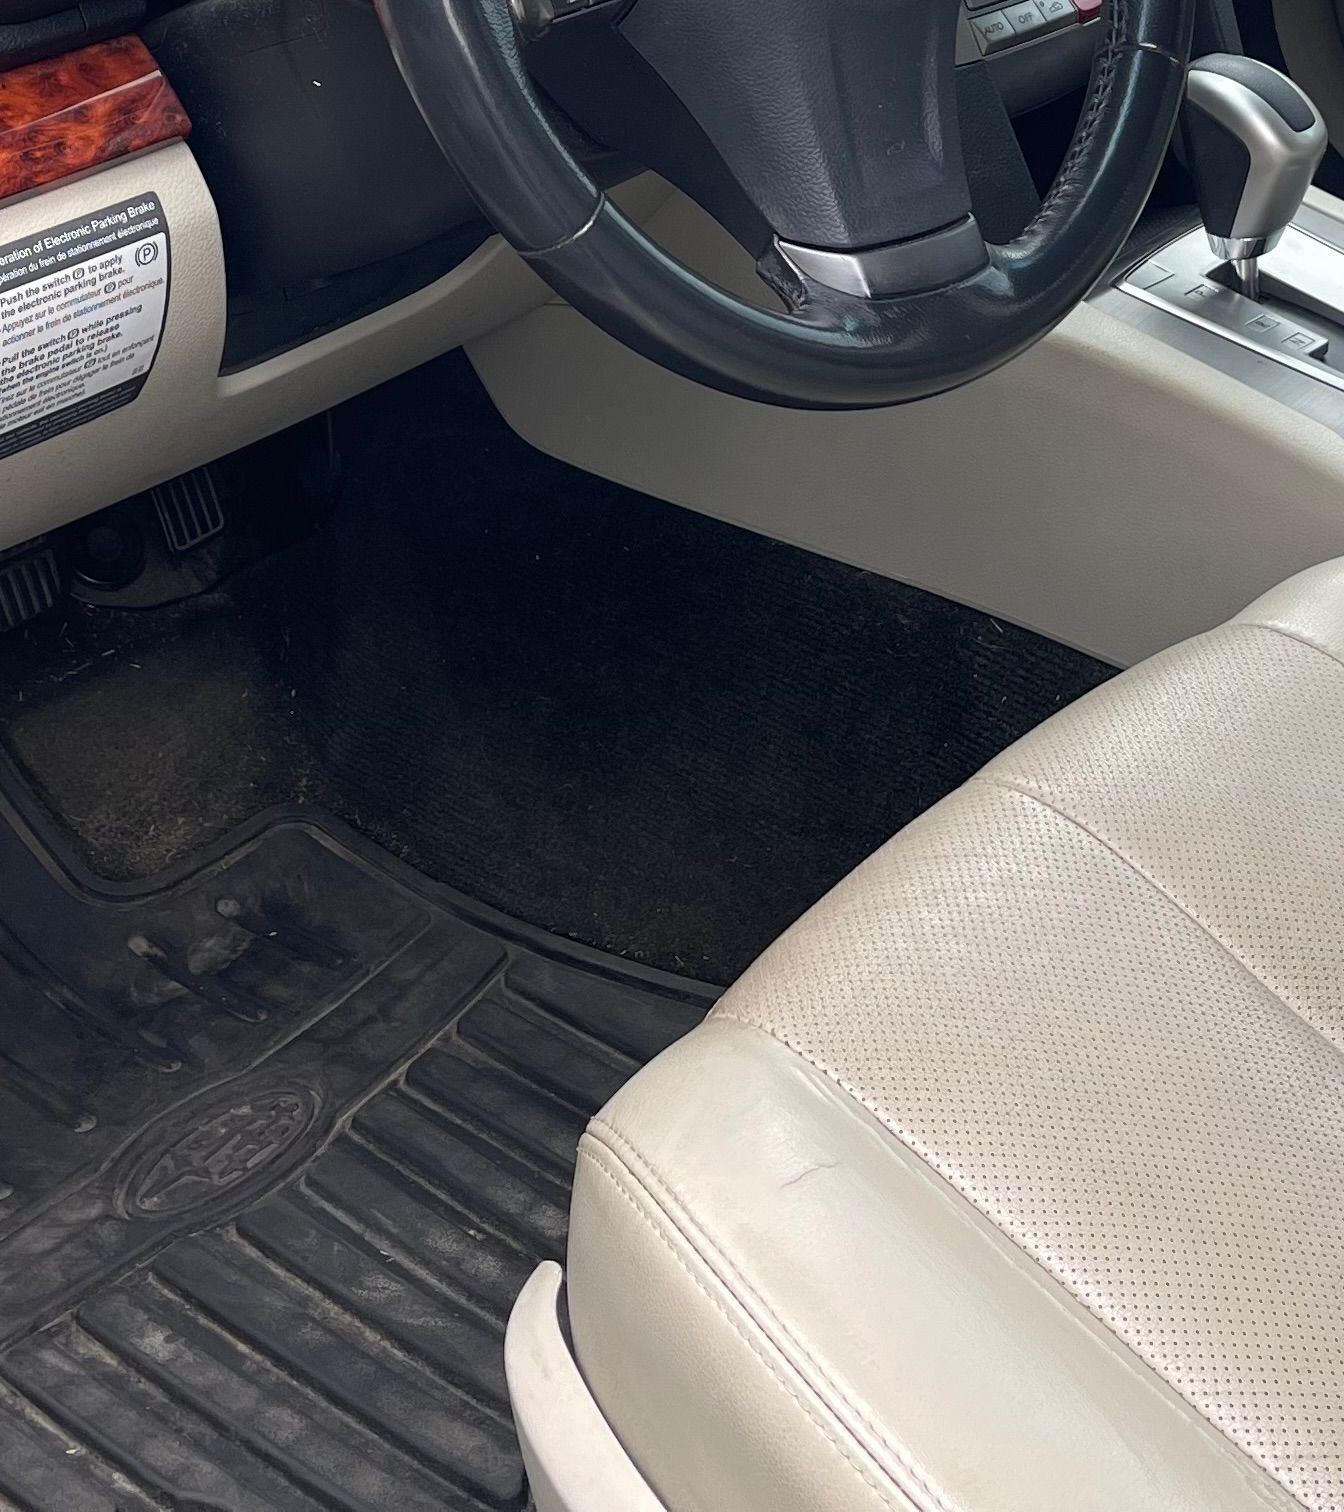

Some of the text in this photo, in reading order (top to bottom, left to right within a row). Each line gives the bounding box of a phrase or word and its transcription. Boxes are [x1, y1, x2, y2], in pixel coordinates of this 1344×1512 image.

[983, 21, 1004, 34] AUTO
[1018, 12, 1033, 24] OFF
[28, 260, 39, 273] du
[39, 253, 56, 268] frein
[56, 249, 67, 262] de
[67, 231, 117, 258] stationnement
[117, 217, 159, 239] électronique
[33, 240, 45, 254] of
[44, 224, 92, 250] Electronic
[91, 211, 128, 233] Parking
[127, 201, 156, 218] Brake
[0, 253, 123, 308] Push the switch to apply
[0, 266, 125, 320] the electronic parking brake.
[1, 315, 34, 334] Appuyez
[34, 310, 47, 322] sur
[55, 287, 102, 312] commutateur
[117, 275, 134, 290] pour
[1, 328, 36, 347] actionner
[45, 316, 62, 330] frein
[62, 311, 72, 323] de
[72, 292, 122, 320] stationnement
[1, 303, 143, 367] Pull the switch while pressing
[0, 323, 120, 377] the brake pedal to release
[0, 332, 123, 386] the electronic parking brake.
[60, 355, 84, 370] switch
